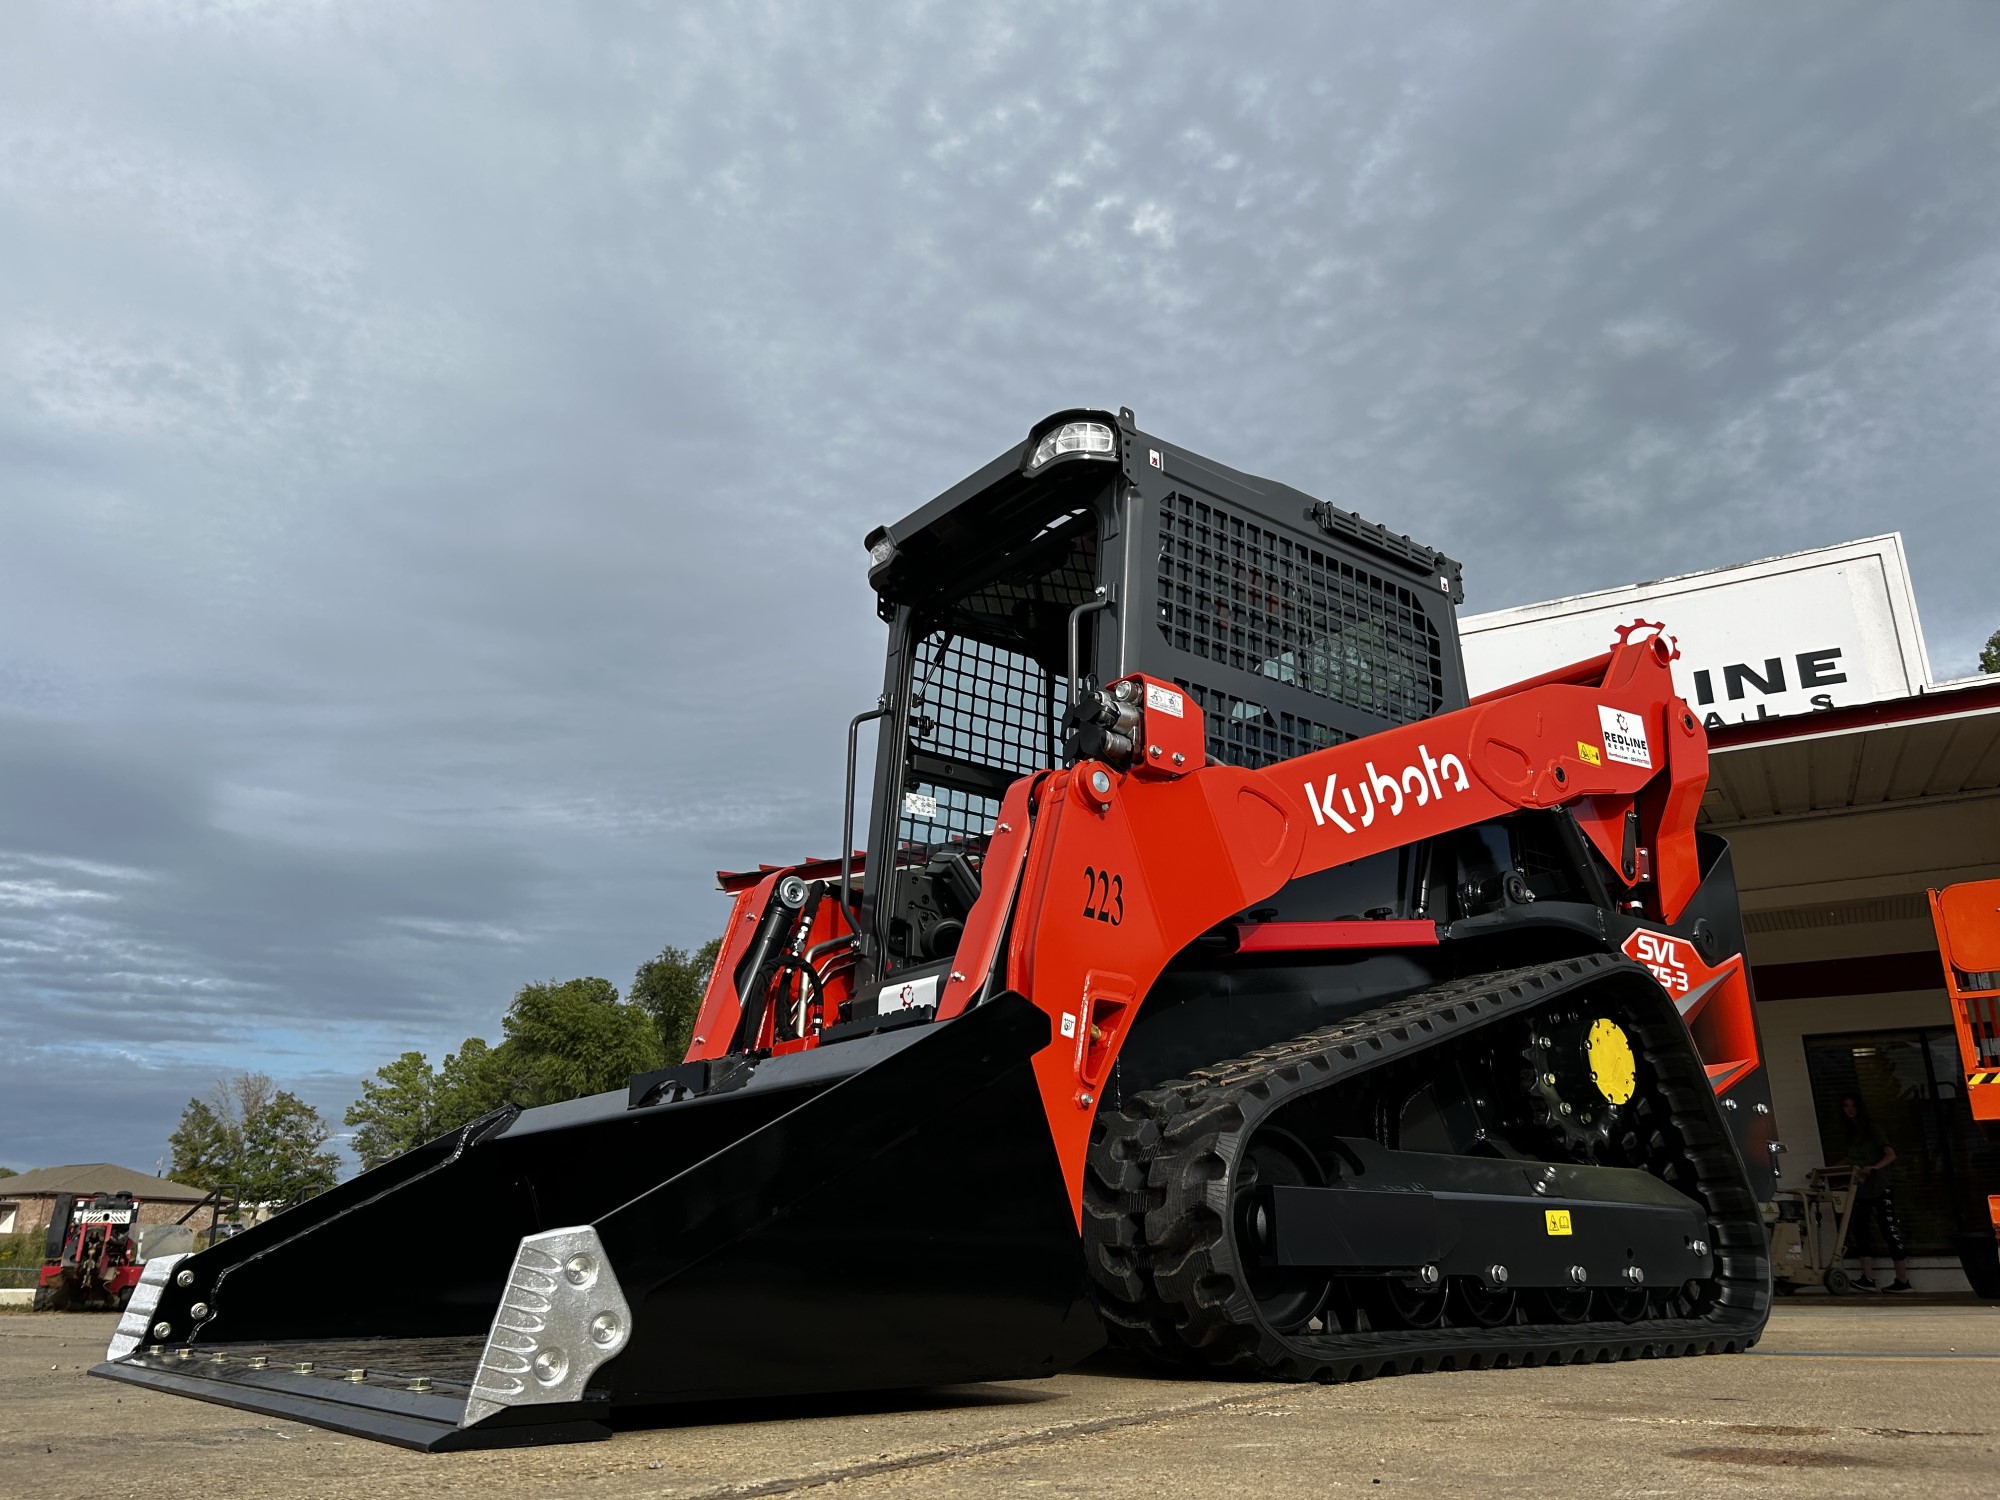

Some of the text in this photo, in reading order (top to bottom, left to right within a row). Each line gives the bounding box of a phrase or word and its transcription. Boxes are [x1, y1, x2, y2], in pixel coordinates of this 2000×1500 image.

[1682, 647, 1847, 706] INE
[1604, 731, 1647, 750] REDLINE
[1608, 743, 1647, 757] RENTALS
[1303, 744, 1470, 834] Kubota
[1083, 866, 1124, 926] 223
[1636, 934, 1685, 969] SVL
[1646, 963, 1689, 992] 75-3
